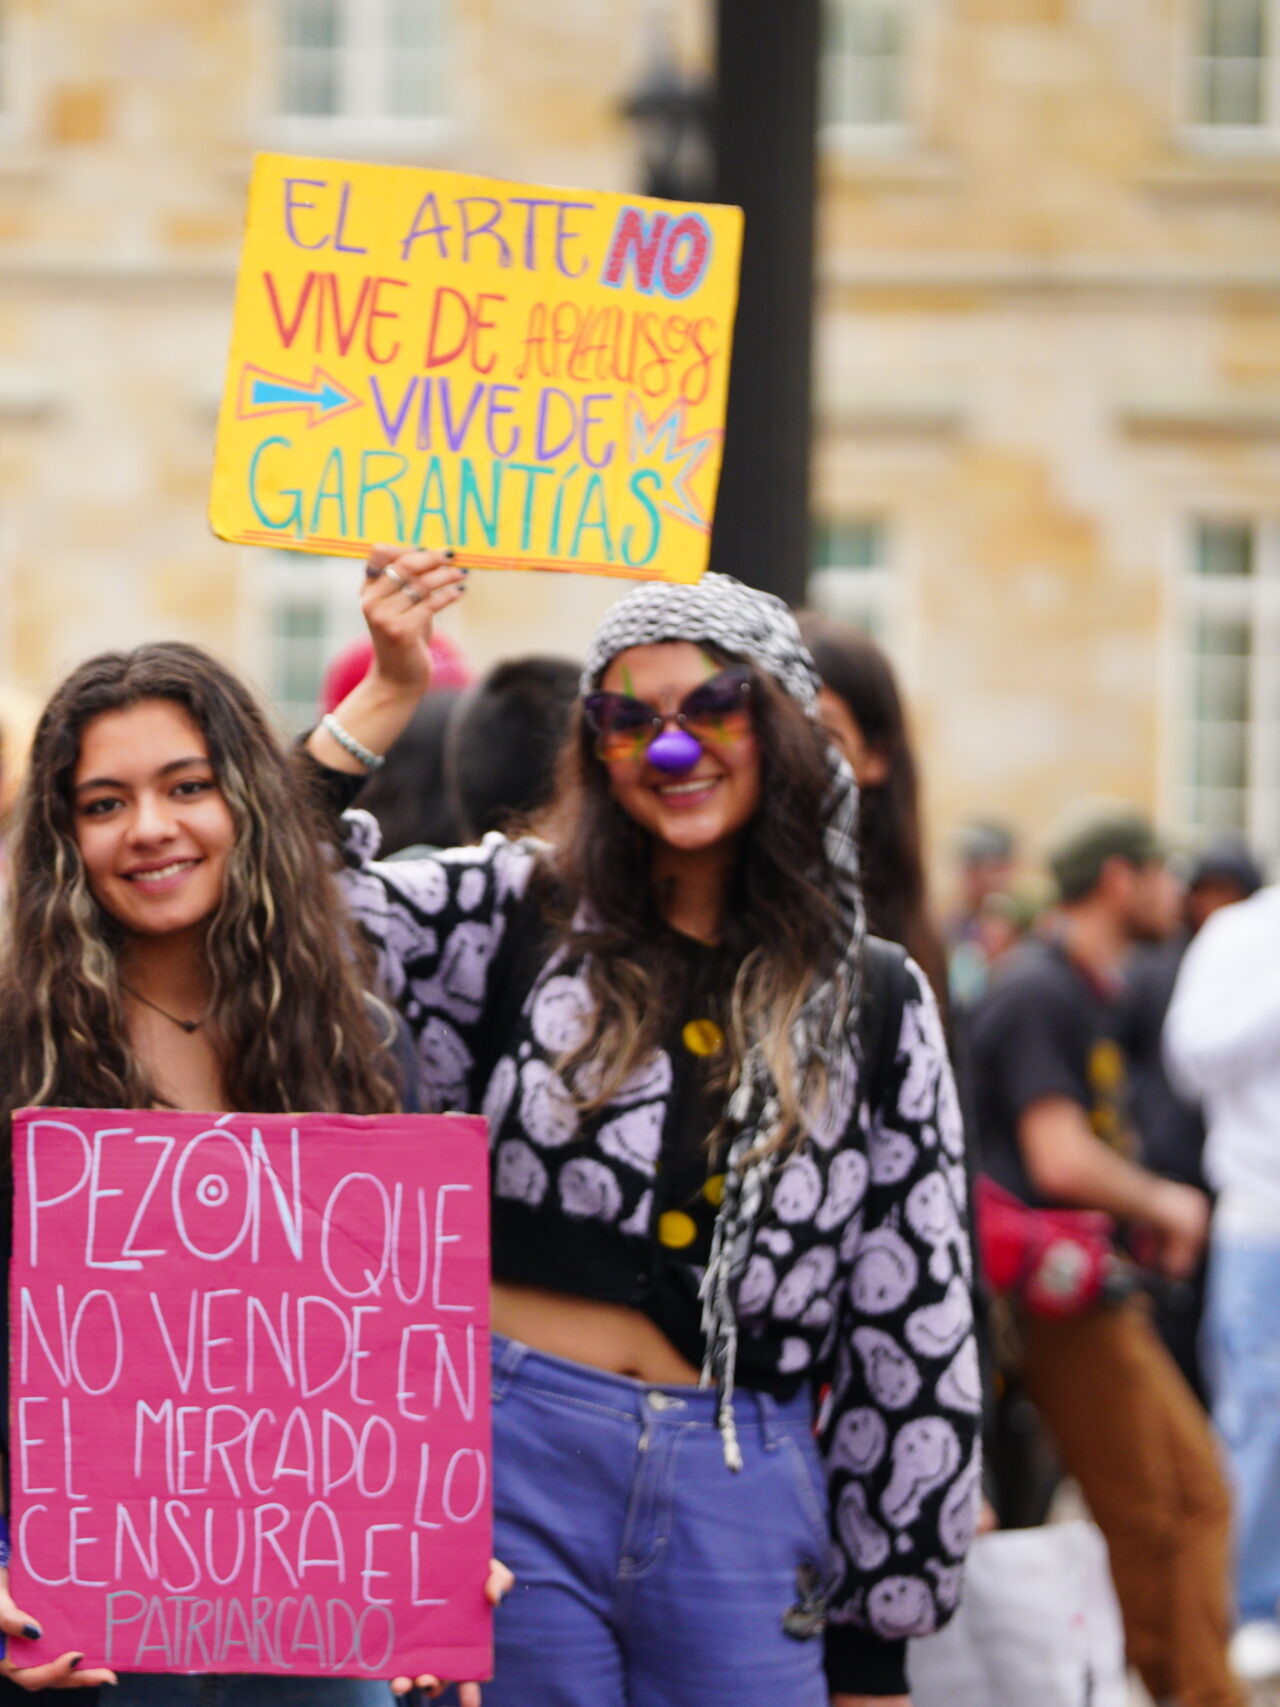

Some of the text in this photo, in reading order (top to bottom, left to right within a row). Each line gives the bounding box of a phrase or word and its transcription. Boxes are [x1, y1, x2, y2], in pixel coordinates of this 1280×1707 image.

[283, 177, 714, 301] EL ARTE NO
[262, 270, 411, 365] VIVE
[424, 286, 507, 375] DE
[368, 376, 617, 469] VIVE DE
[249, 435, 663, 568] GARANTÍAS
[26, 1113, 475, 1312] PEZÓN QUE
[20, 1285, 475, 1421] NO VENDE EN
[18, 1396, 486, 1529] EL MERCADO LO
[18, 1496, 447, 1605] CENSURA EL
[105, 1590, 395, 1672] PATRIARCADO
